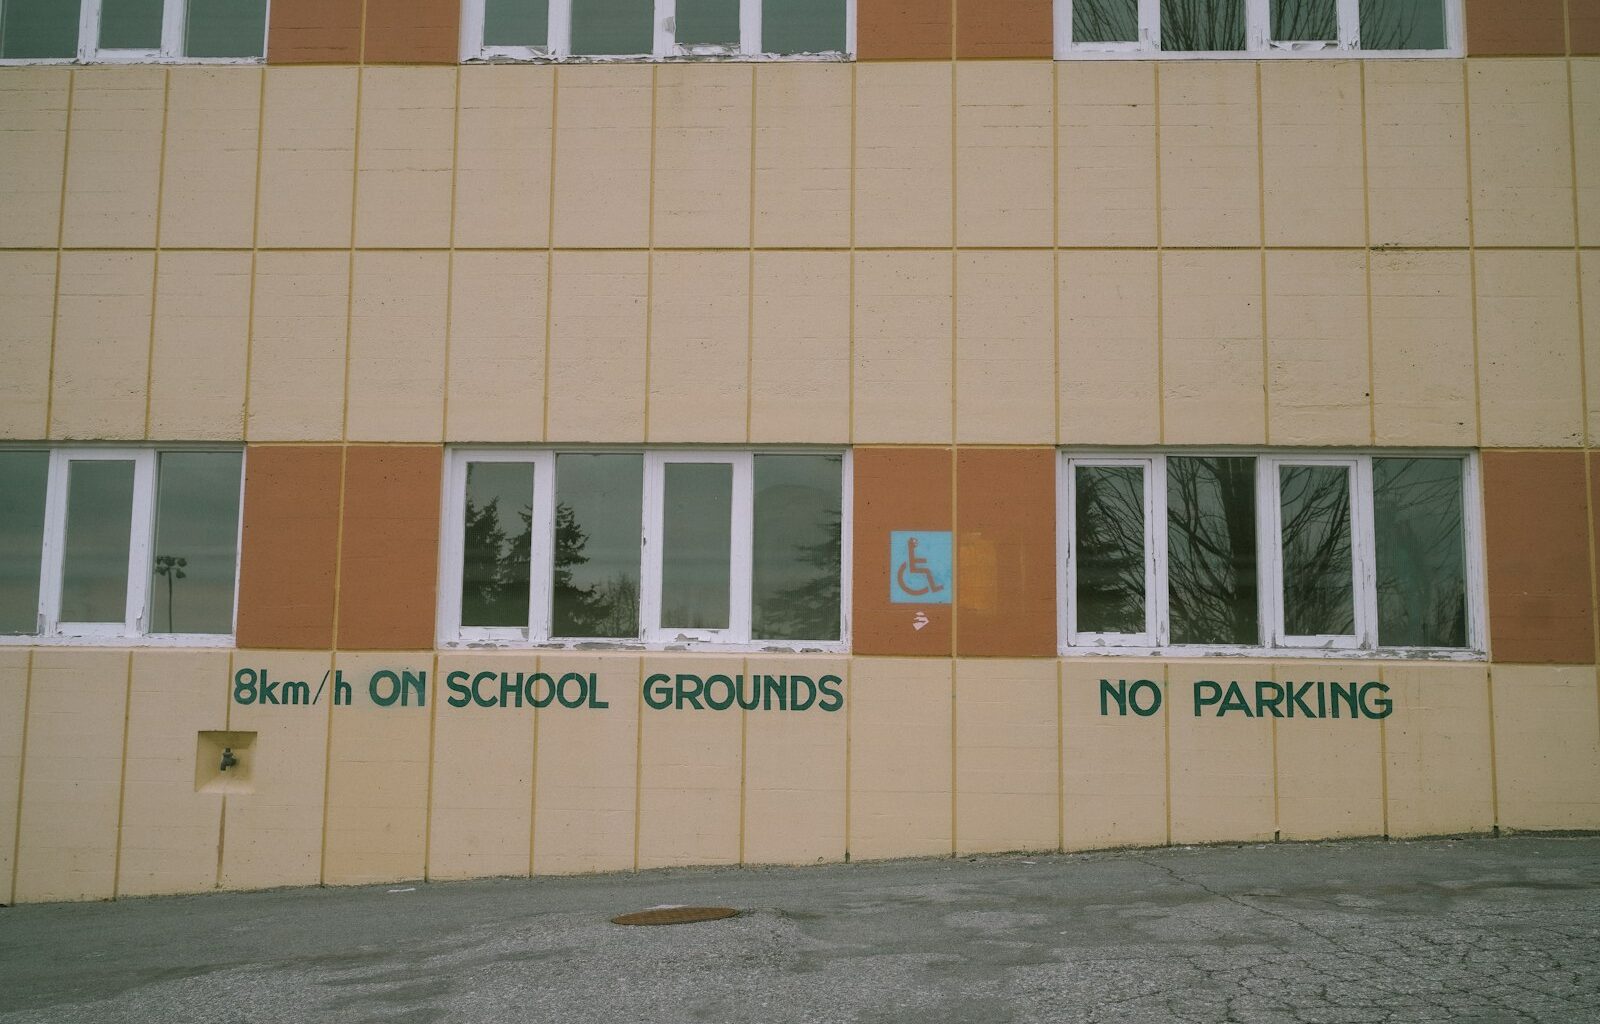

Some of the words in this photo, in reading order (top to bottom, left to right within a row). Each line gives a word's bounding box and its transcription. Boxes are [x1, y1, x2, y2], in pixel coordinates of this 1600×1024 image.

[233, 667, 352, 706] 8km/h
[368, 669, 427, 708] ON
[446, 670, 610, 709] SCHOOL
[642, 673, 844, 713] GROUNDS
[1099, 678, 1163, 717] NO
[1193, 680, 1394, 720] PARKING
